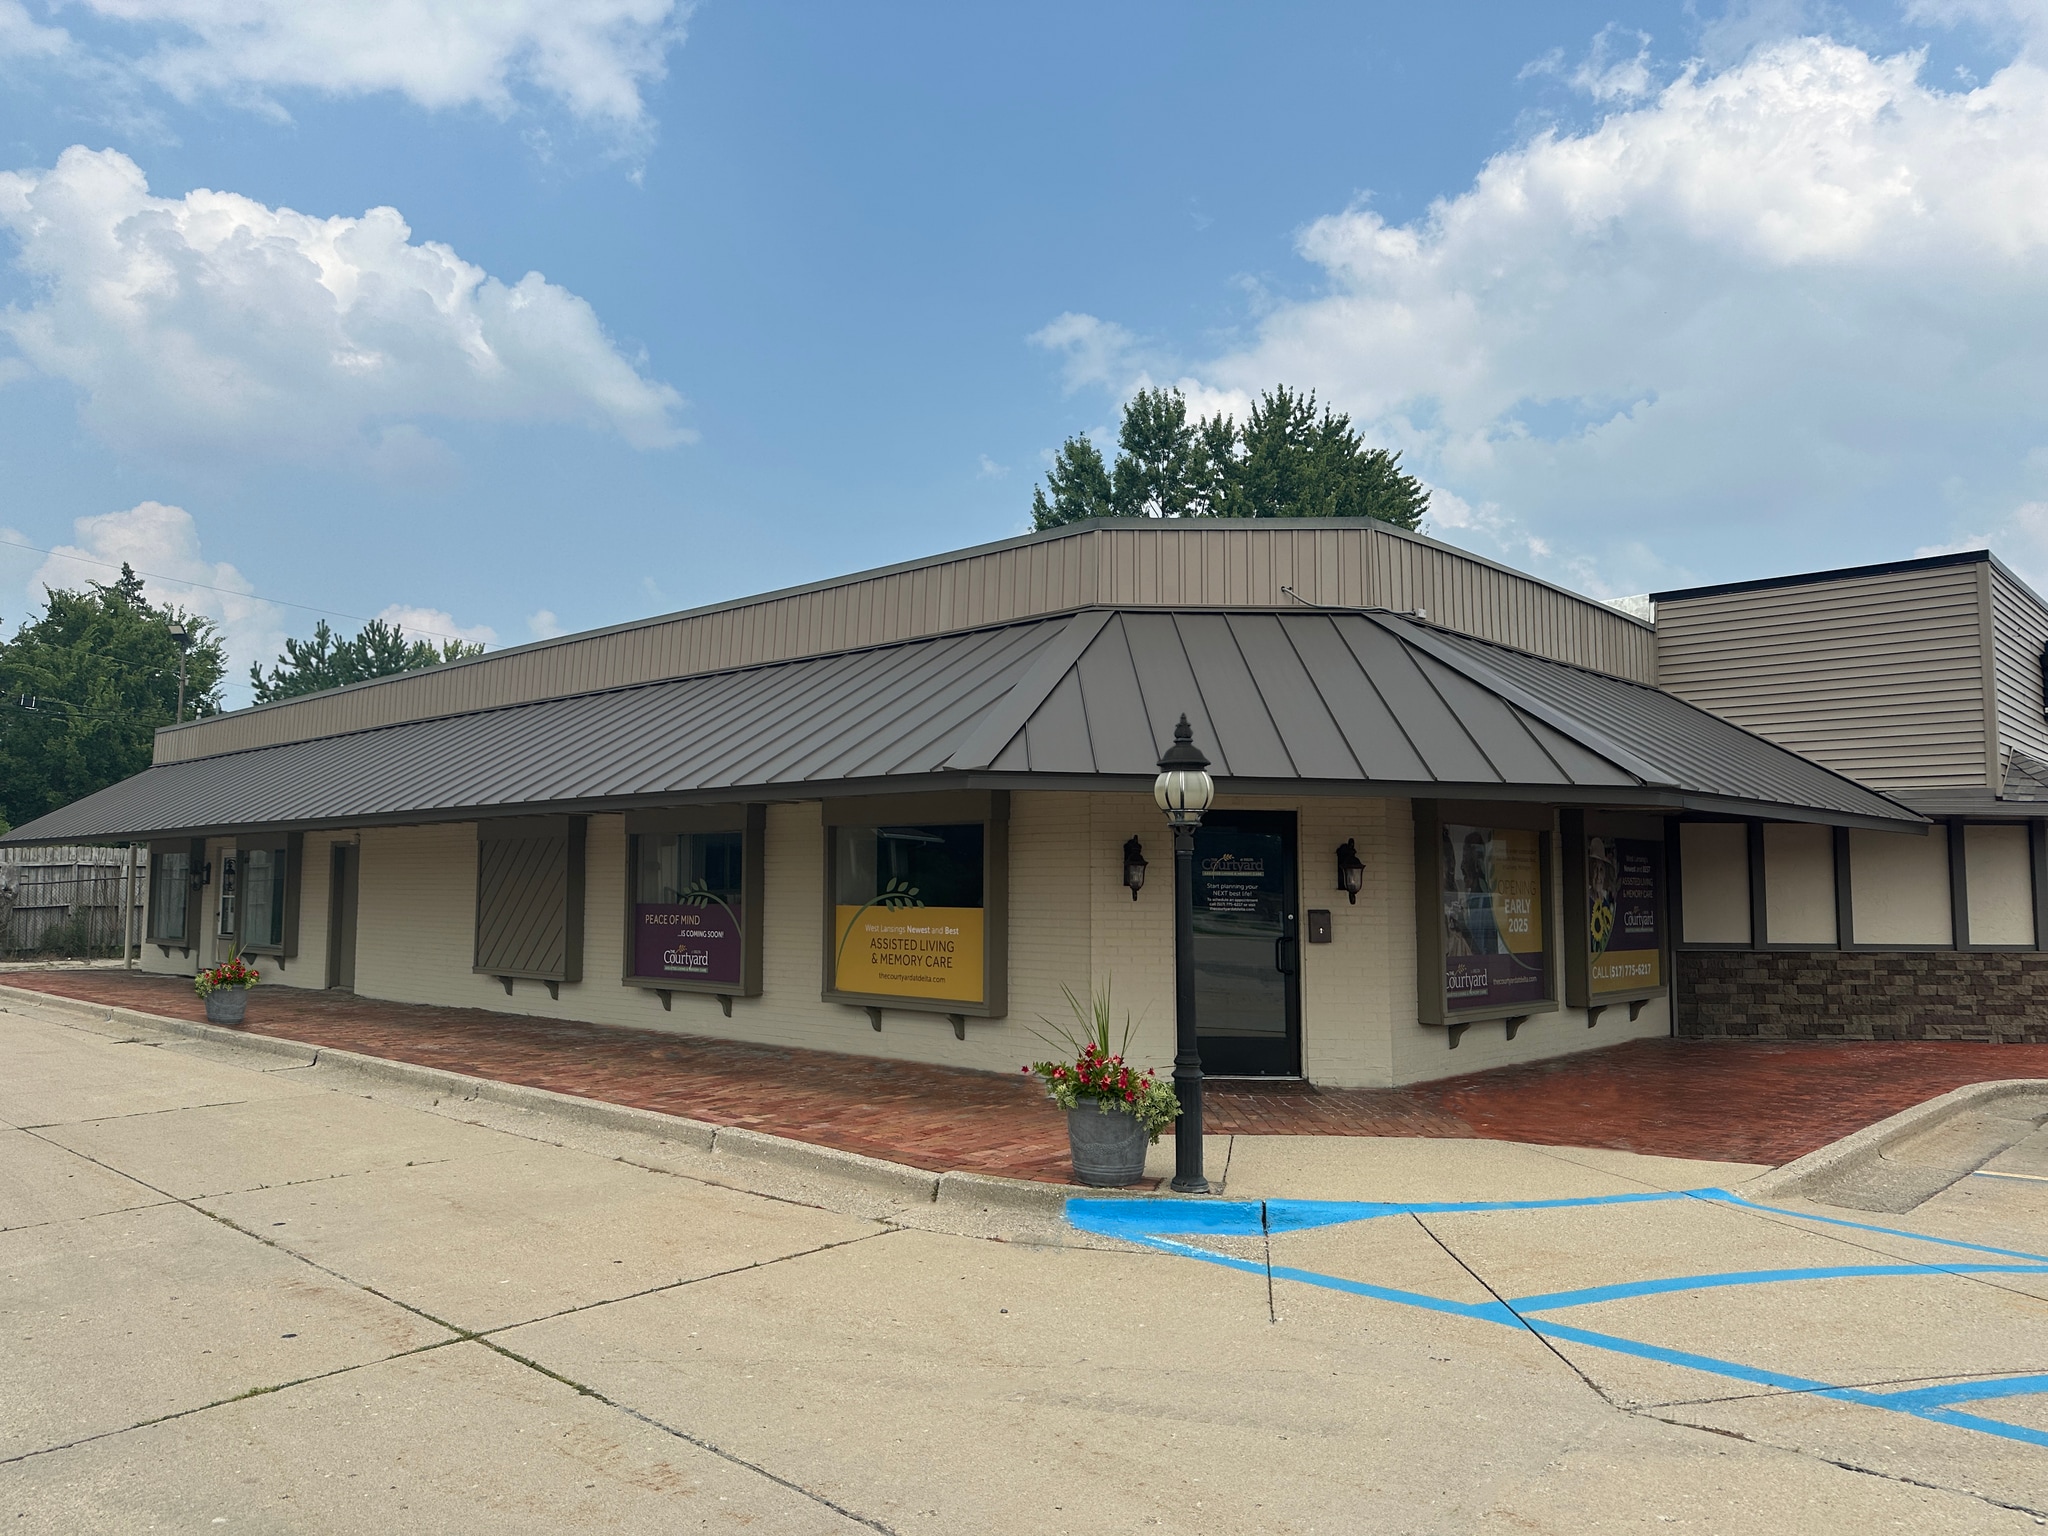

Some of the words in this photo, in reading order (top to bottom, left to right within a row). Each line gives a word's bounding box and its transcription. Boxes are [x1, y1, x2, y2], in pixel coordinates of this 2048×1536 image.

[1201, 858, 1264, 873] Courtyard
[1497, 880, 1537, 896] OPENING
[1504, 898, 1531, 914] EARLY
[645, 914, 668, 925] PEACE
[669, 914, 680, 925] OF
[680, 915, 701, 926] MIND
[1508, 918, 1529, 933] 2025
[1623, 910, 1654, 929] Courtyard
[686, 930, 707, 938] COMING
[865, 924, 879, 932] West
[907, 925, 930, 934] Newest
[931, 926, 944, 934] and
[944, 926, 959, 935] Best
[870, 937, 918, 951] ASSISTED
[920, 939, 955, 953] LIVING
[664, 950, 708, 969] Courtyard
[871, 952, 878, 964] &
[880, 953, 922, 967] MEMORY
[925, 955, 953, 969] CARE
[879, 972, 946, 984] thecourtyardatdelta.com
[1592, 966, 1609, 979] CALL
[1609, 964, 1625, 979] (517)
[1624, 963, 1651, 976] 775-6217
